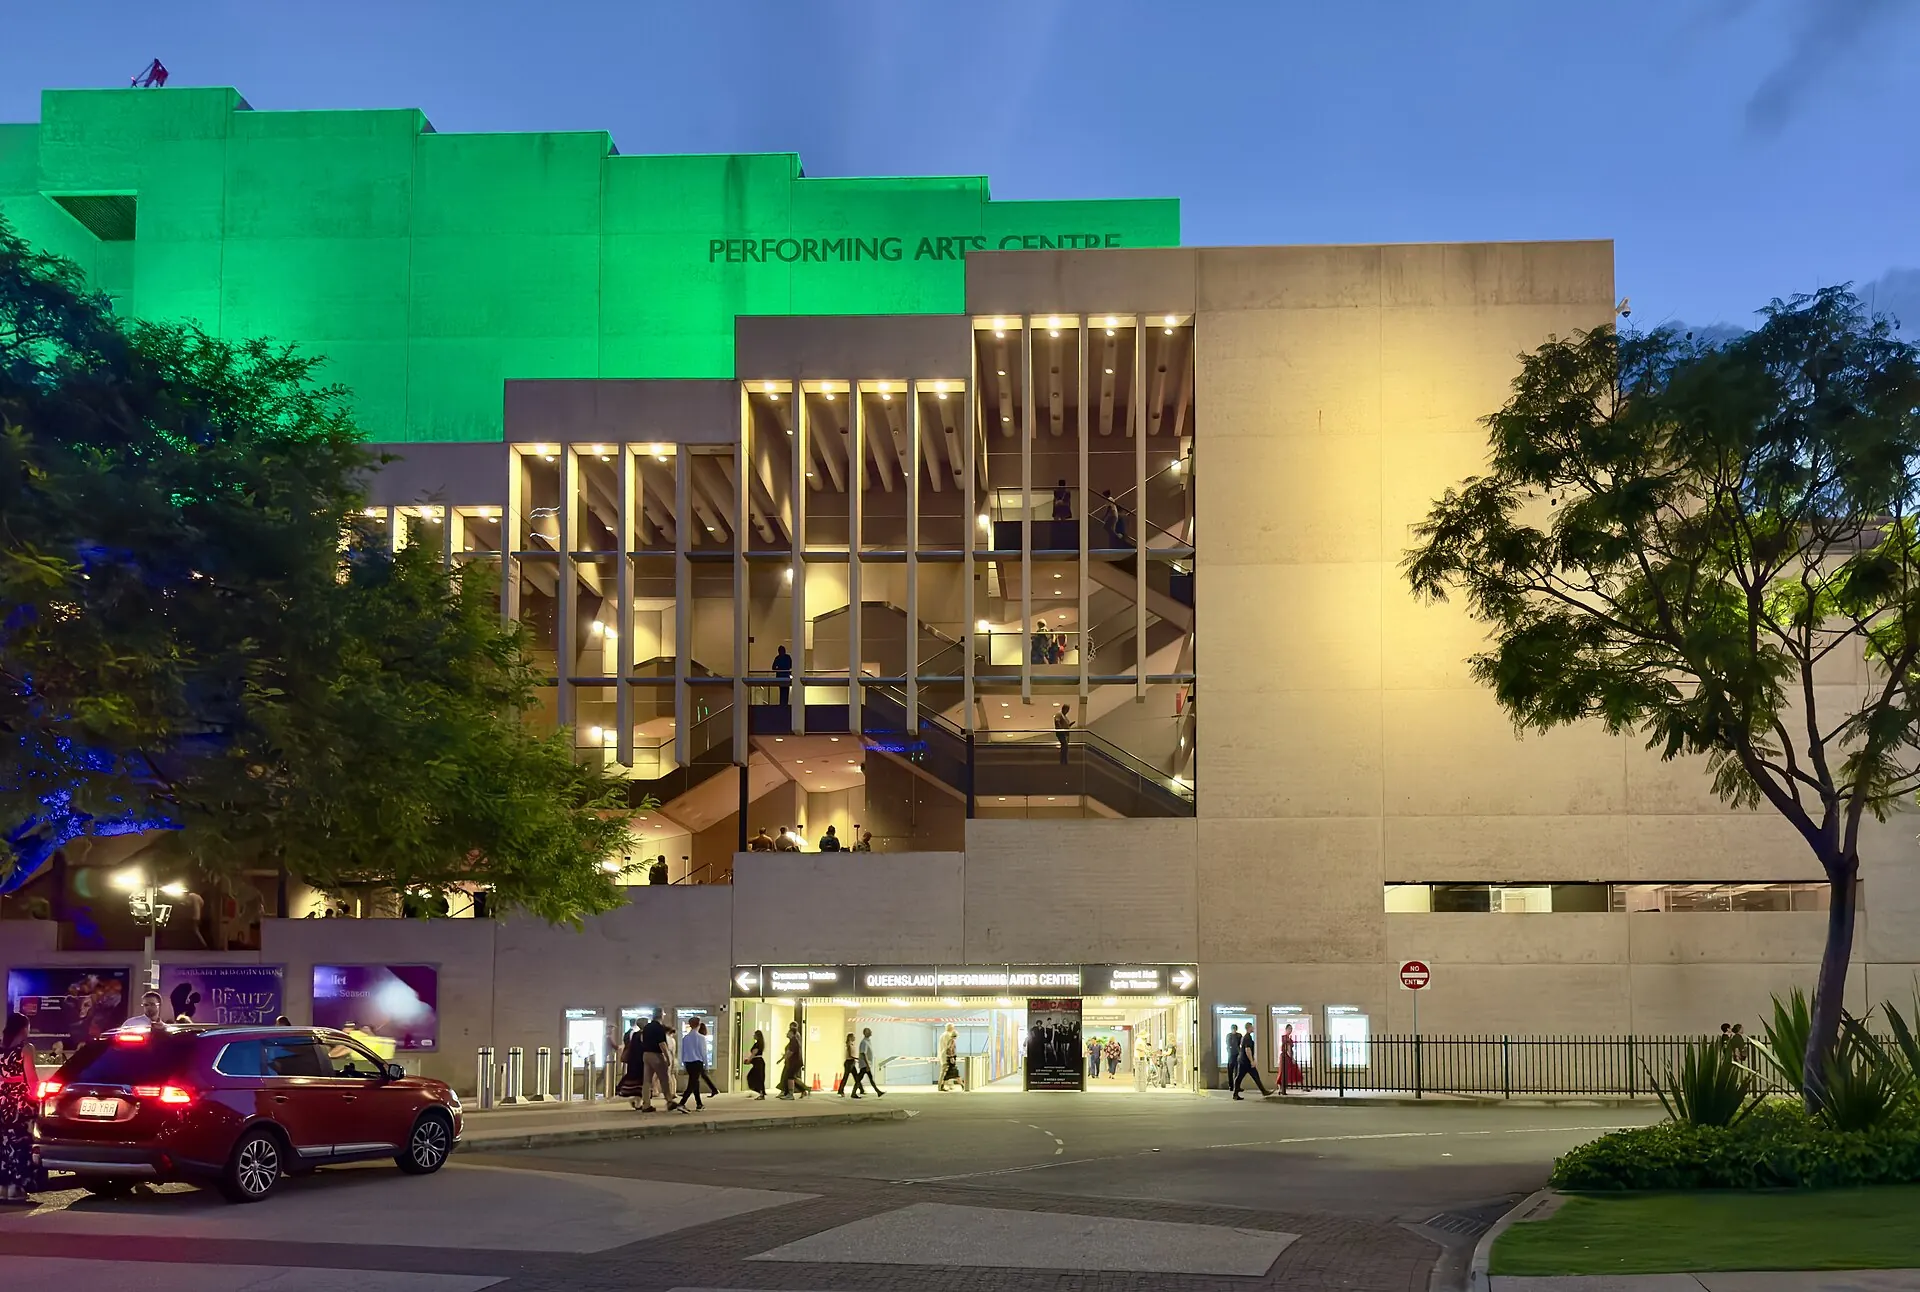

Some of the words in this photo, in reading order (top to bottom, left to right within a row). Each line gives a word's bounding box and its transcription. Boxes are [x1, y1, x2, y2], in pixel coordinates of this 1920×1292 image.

[709, 237, 903, 263] PERFORMING
[914, 235, 987, 260] ARTS
[866, 974, 935, 987] QUEENSLAND
[937, 974, 1008, 986] PERFORMING
[1009, 974, 1037, 986] ARTS
[1039, 973, 1079, 985] CENTRE
[339, 989, 371, 998] Season
